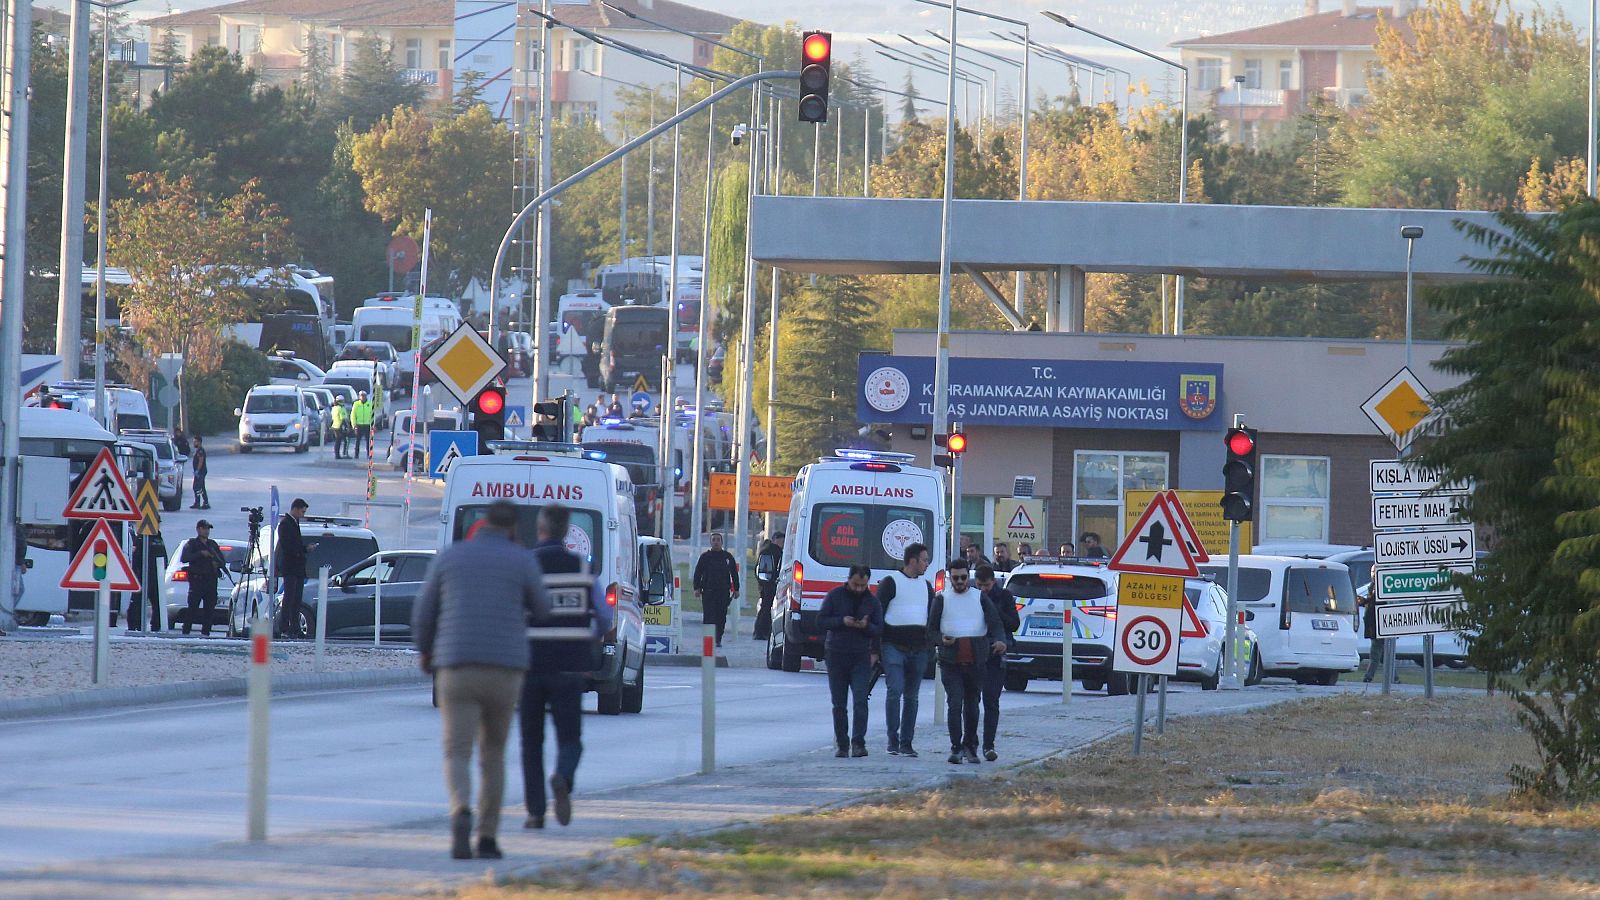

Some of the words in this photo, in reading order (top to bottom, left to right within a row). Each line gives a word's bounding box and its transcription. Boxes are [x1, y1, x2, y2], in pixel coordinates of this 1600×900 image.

[1032, 366, 1056, 379] T.C.
[922, 384, 1053, 398] KHRAMANKAZAN
[1057, 386, 1166, 401] KAYMAKAMLIĞI
[919, 403, 966, 418] TUAŞ
[970, 404, 1049, 417] JANDARMA
[1052, 404, 1102, 421] ASAYİŞ
[1107, 407, 1168, 420] NOKTASI
[1376, 468, 1411, 485] KIŞLA
[472, 482, 583, 500] AMBULANS
[831, 485, 914, 498] AMBULANS
[1424, 503, 1448, 517] MAH.
[1007, 531, 1035, 540] YAVAŞ
[1424, 535, 1448, 554] ÜSSÜ
[1131, 590, 1171, 600] BÖLGESİ
[643, 606, 661, 615] NLİK
[1382, 611, 1423, 628] KAHRAMAN
[1133, 629, 1160, 651] 30
